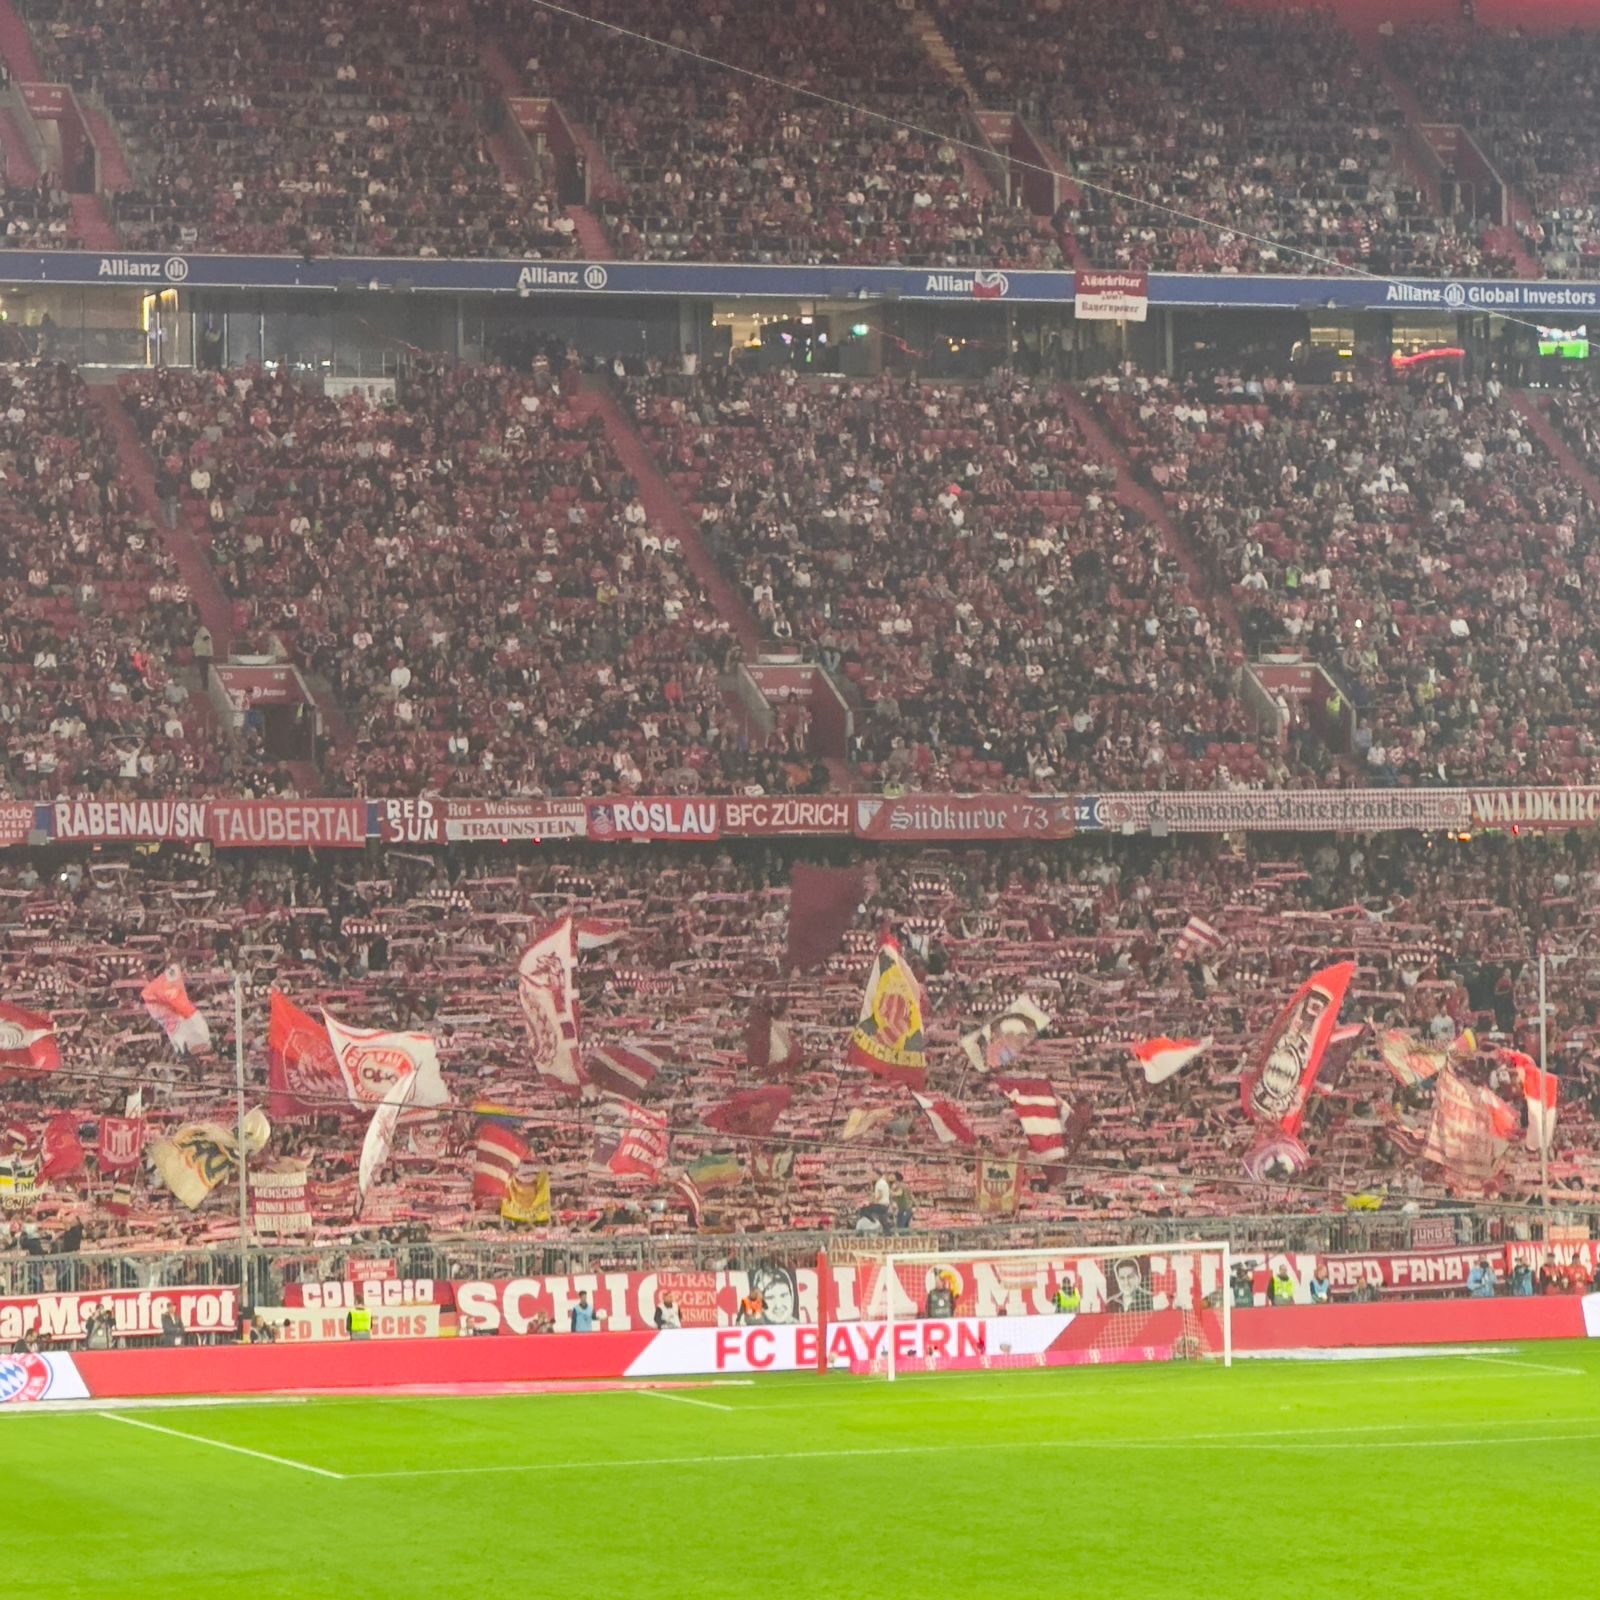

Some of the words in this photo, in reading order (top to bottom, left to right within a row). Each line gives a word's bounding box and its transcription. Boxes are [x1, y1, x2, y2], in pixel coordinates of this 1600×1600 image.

[99, 259, 160, 276] Allianz
[519, 267, 579, 284] Allianz
[926, 275, 974, 292] Allian
[1387, 285, 1440, 301] Allianz
[1468, 286, 1519, 303] Global
[1523, 288, 1596, 305] Investors
[55, 801, 206, 838] RABENAU/SN
[386, 800, 433, 819] RED
[450, 802, 472, 817] Rot
[485, 801, 531, 816] Weisse
[612, 801, 716, 834] RÖSLAU
[726, 804, 767, 827] BFC
[771, 800, 849, 827] ZÜRICH
[890, 804, 1008, 831] Südkurve
[213, 806, 366, 842] TAUBERTAL
[390, 818, 438, 843] SUN
[460, 820, 577, 836] TRAUNSTEIN
[659, 1272, 716, 1288] ULTRAS
[1327, 1259, 1384, 1288] RED
[1390, 1251, 1504, 1285] FANATC
[180, 1289, 237, 1330] rot
[276, 1319, 312, 1340] ED
[715, 1329, 777, 1369] FC
[795, 1320, 987, 1366] BAYERN
